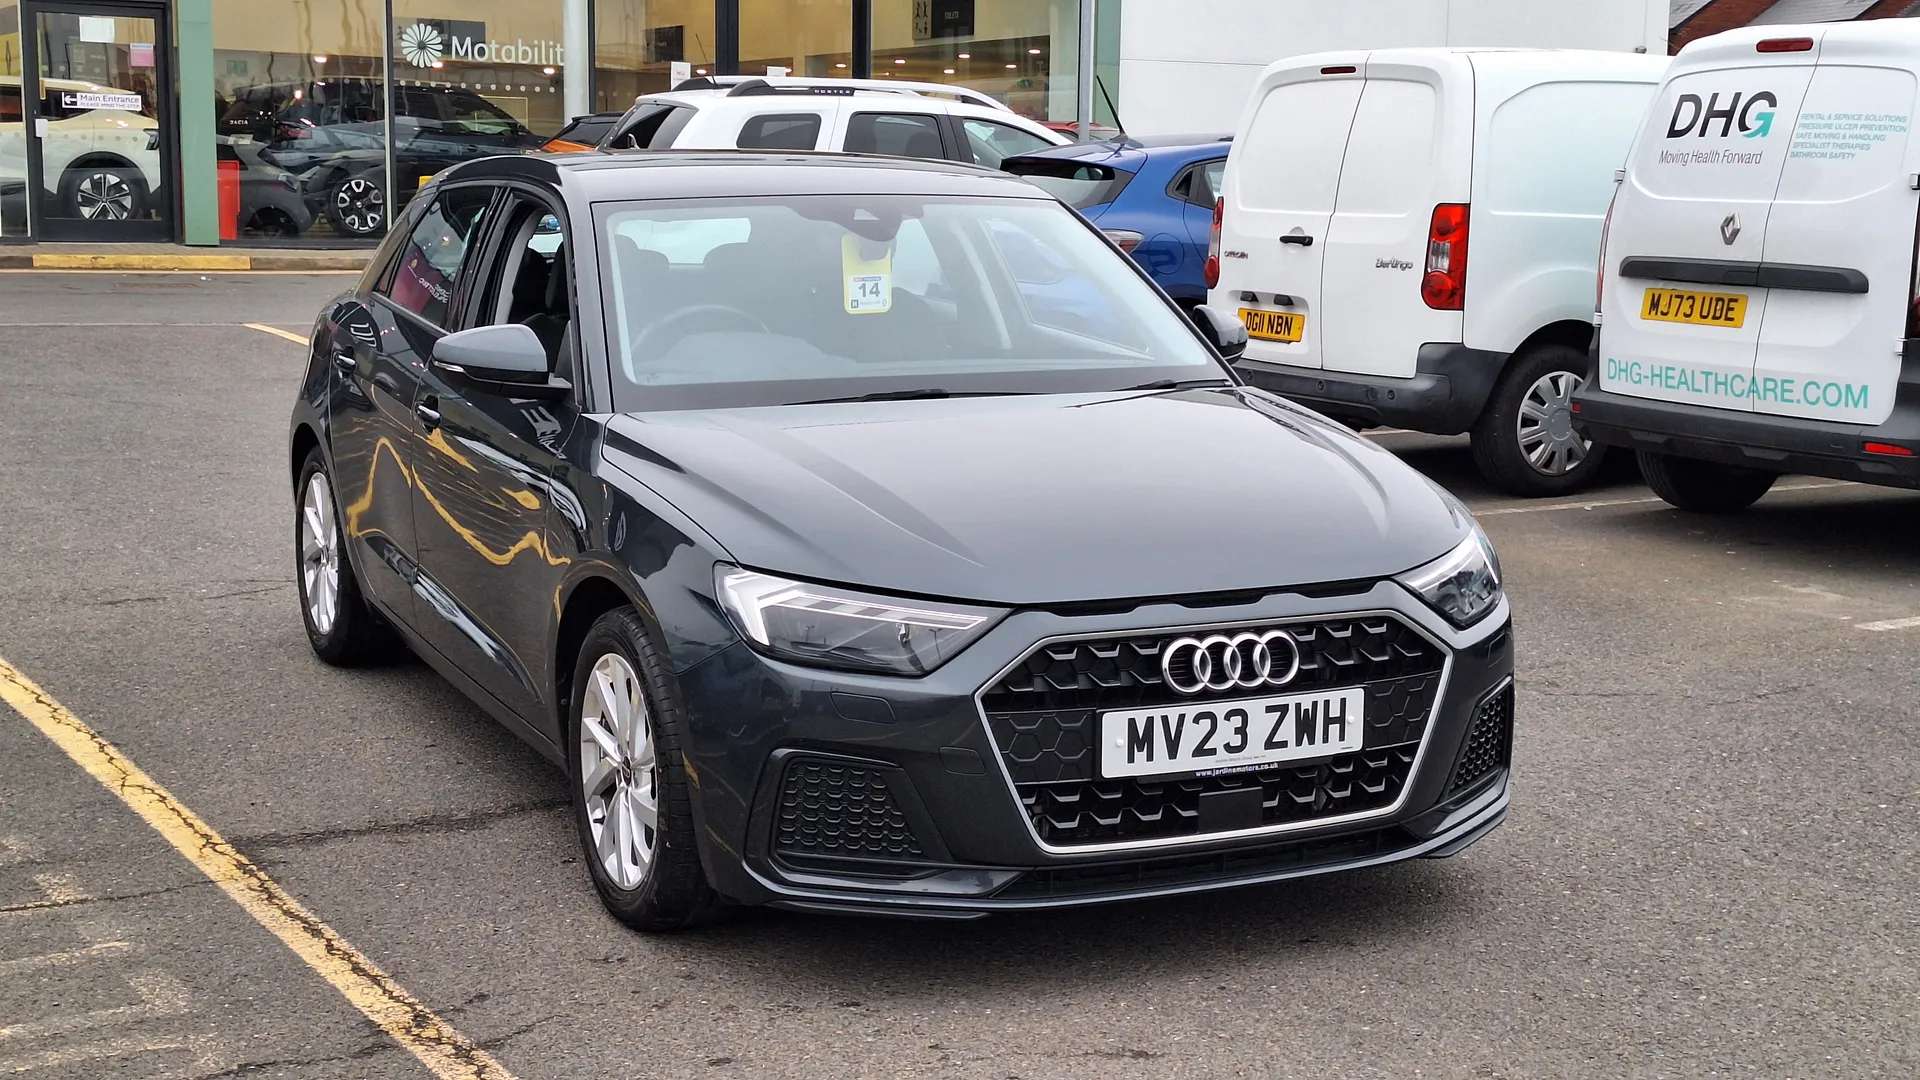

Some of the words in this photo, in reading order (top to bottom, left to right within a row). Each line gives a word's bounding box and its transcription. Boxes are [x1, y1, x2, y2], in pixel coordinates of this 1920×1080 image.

[451, 36, 564, 65] Motabilit
[80, 94, 101, 102] Main
[103, 95, 140, 104] Entrance
[1666, 91, 1777, 138] DHG
[1800, 112, 1826, 121] RENTAL
[1834, 113, 1864, 121] SERVICE
[1865, 114, 1908, 122] SOLUTIONS
[1798, 122, 1833, 130] PRESSURE
[1860, 123, 1908, 132] PREVENTION
[1796, 132, 1813, 140] SAFE
[1814, 132, 1841, 140] MOVING
[1848, 133, 1887, 142] HANDLING
[1792, 141, 1831, 149] SPECIALIST
[1832, 142, 1872, 151] THERAPIES
[1660, 149, 1690, 167] Moving
[1690, 149, 1720, 164] Health
[1721, 149, 1763, 165] Forward
[1790, 151, 1828, 159] BATHROOM
[1828, 151, 1856, 160] SAFETY
[1375, 257, 1414, 271] Berlingo
[858, 282, 880, 298] 14
[1648, 292, 1696, 319] MJ73
[1699, 295, 1739, 322] UDE
[1266, 314, 1293, 336] NBN
[1607, 358, 1869, 409] DHG-HEALTHCARE.COM
[1127, 708, 1249, 764] MV23
[1264, 697, 1347, 750] ZWH
